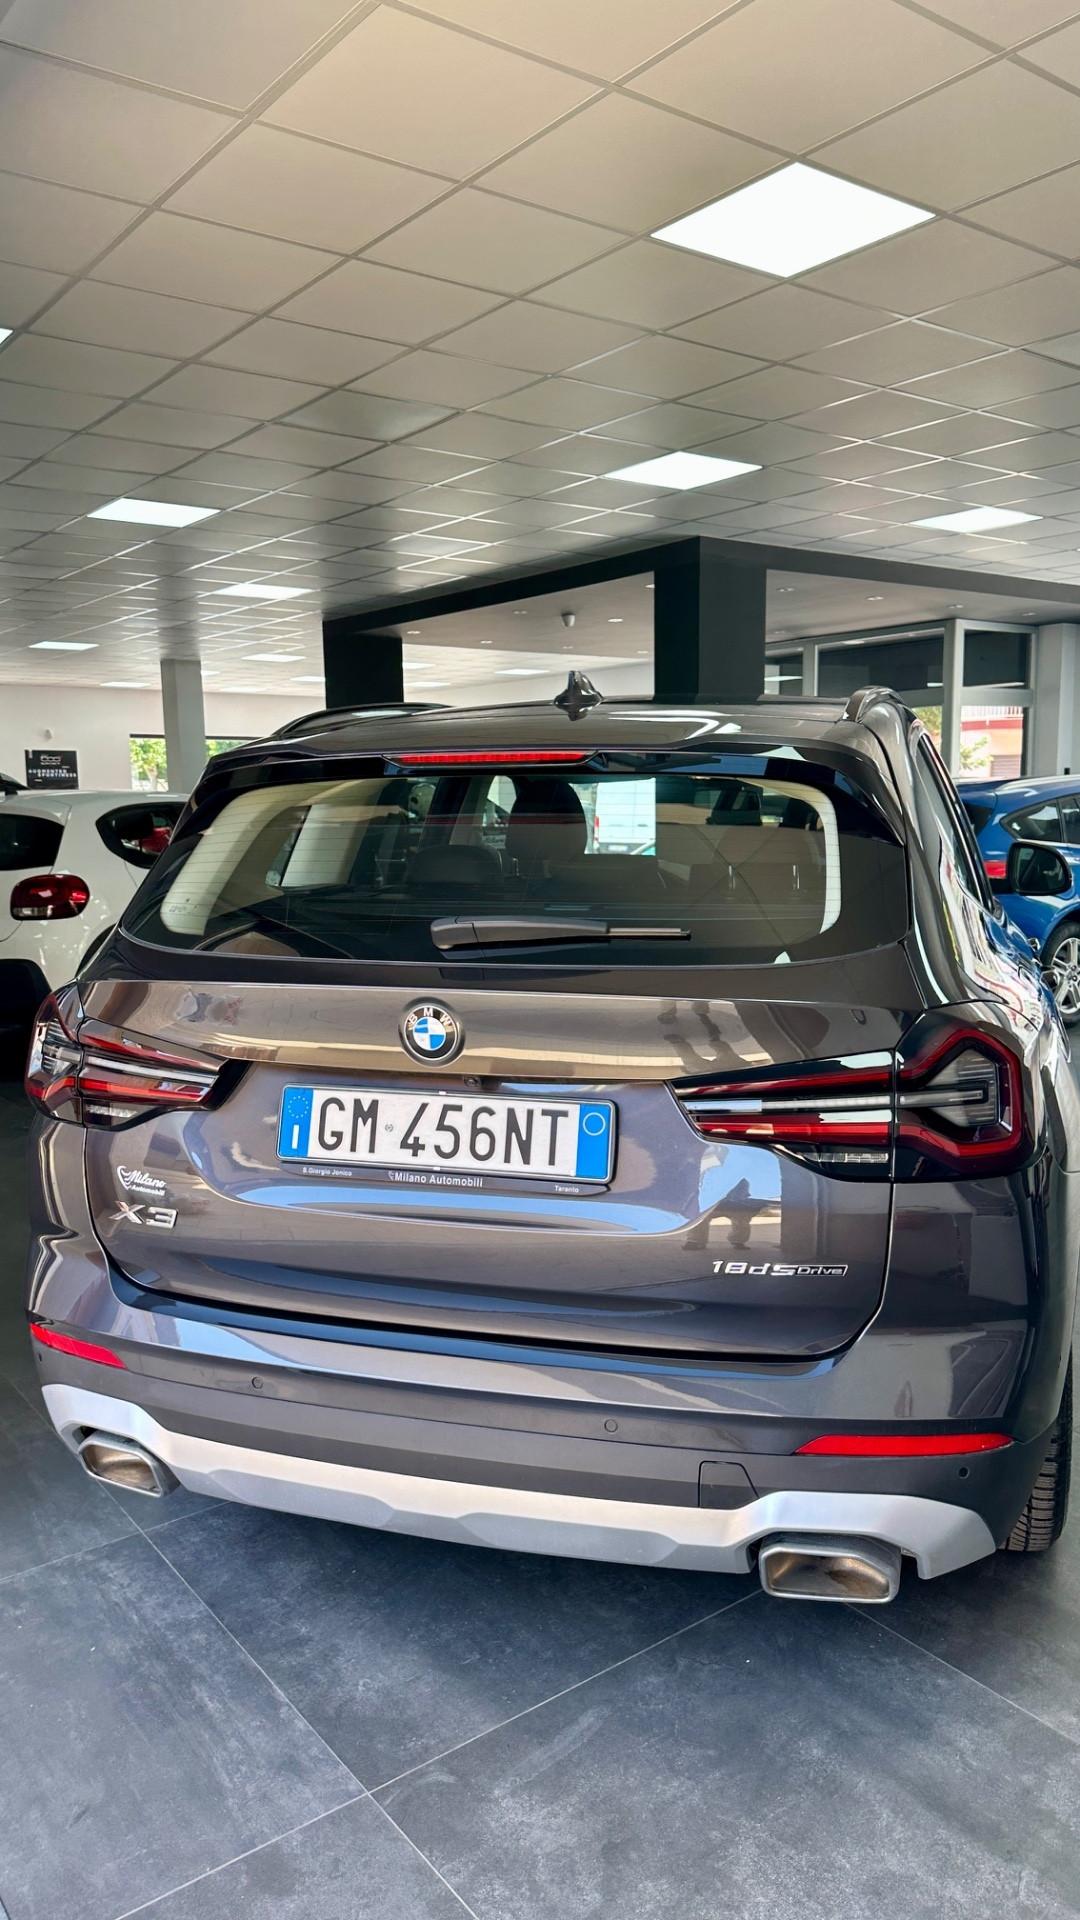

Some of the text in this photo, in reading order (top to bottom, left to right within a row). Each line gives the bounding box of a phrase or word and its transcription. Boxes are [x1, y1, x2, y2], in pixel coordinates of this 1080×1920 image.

[407, 1007, 456, 1032] BMW
[124, 1169, 167, 1188] Milano
[394, 1172, 483, 1188] Milano Automobili
[555, 1184, 580, 1193] Taranto
[108, 1200, 178, 1229] X3
